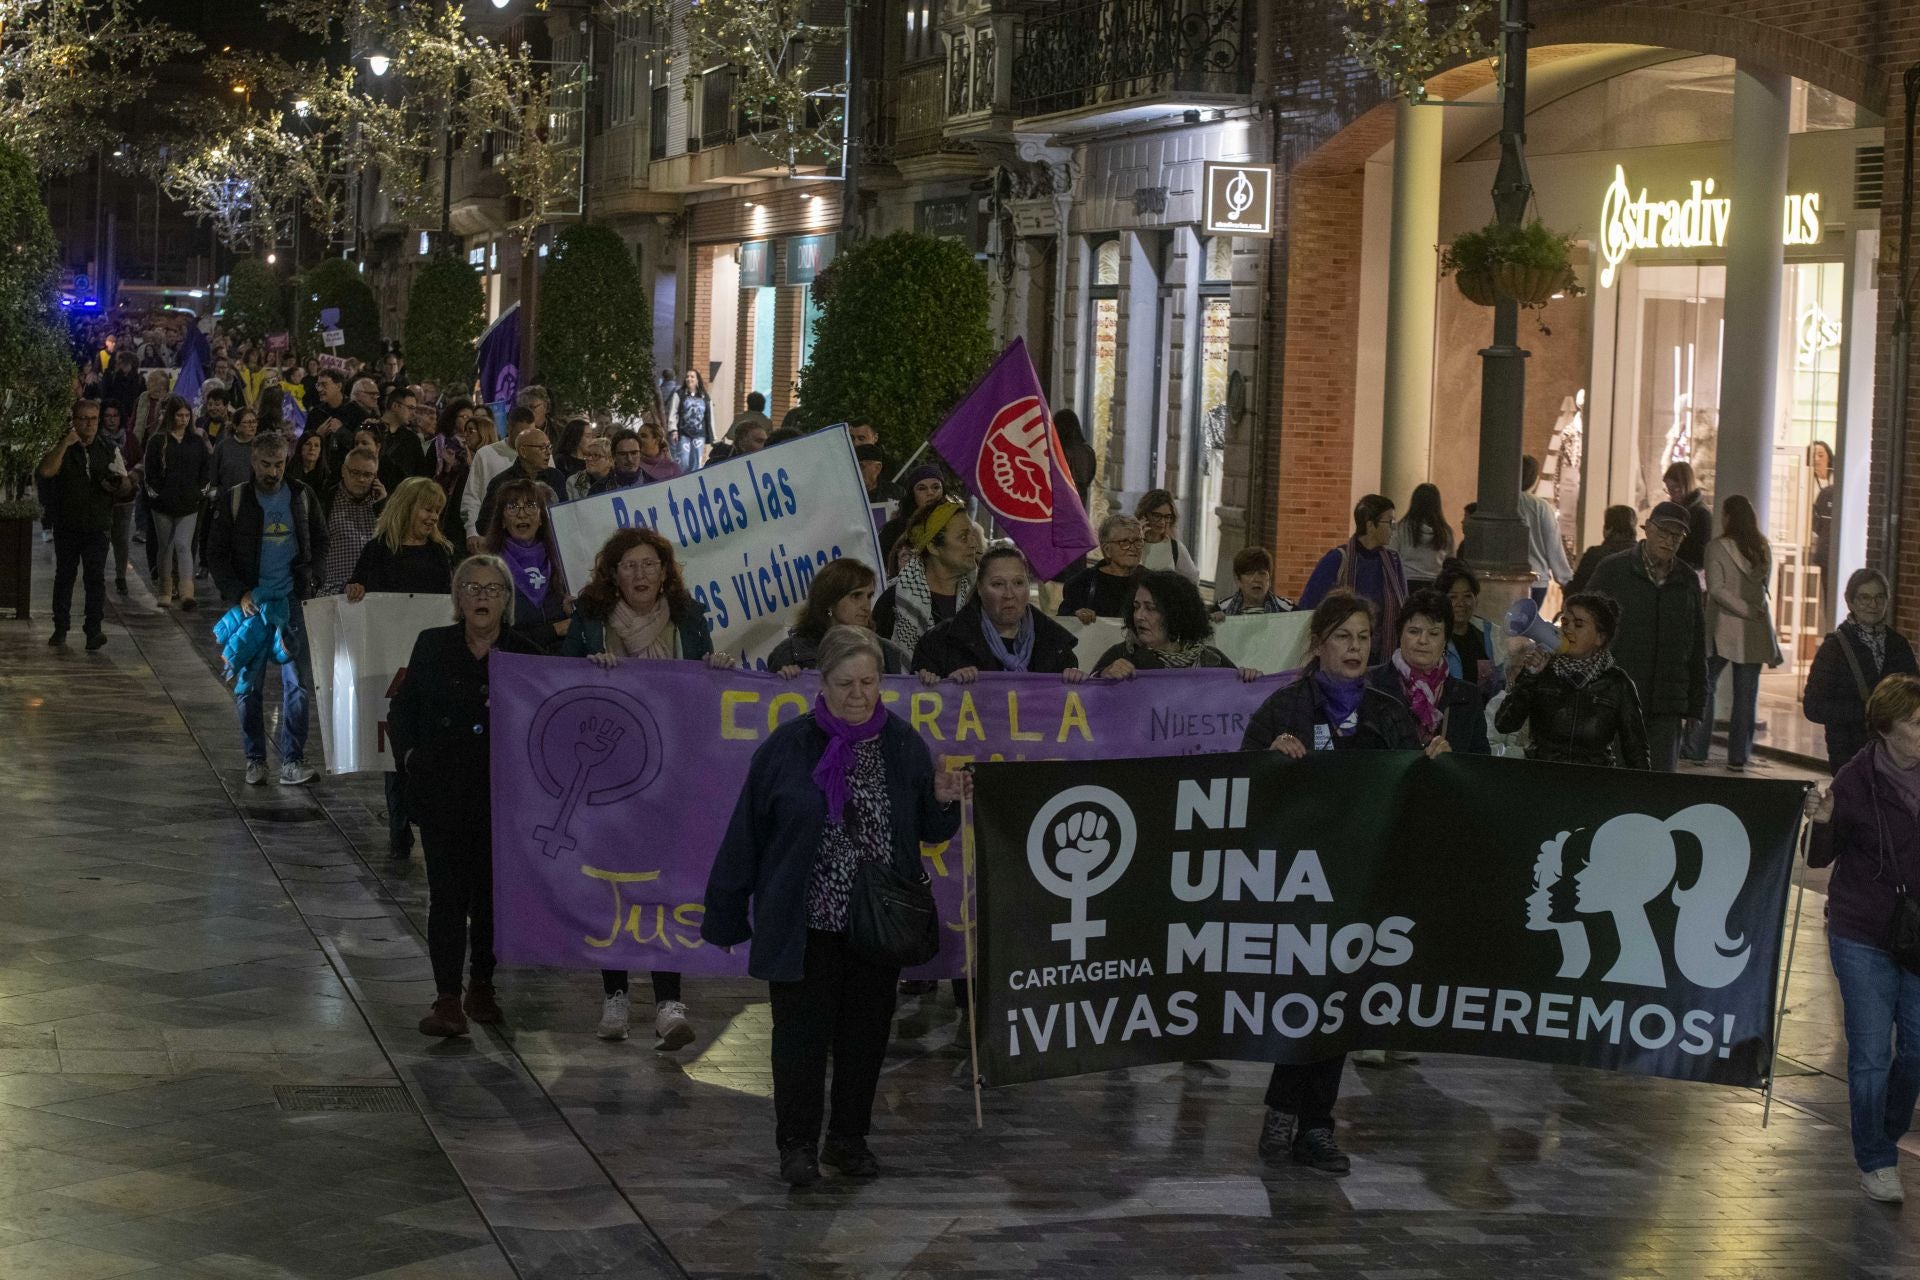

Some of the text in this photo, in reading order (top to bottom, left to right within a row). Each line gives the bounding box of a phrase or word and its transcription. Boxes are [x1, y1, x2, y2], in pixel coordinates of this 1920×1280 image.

[1622, 178, 1820, 249] stradivus
[668, 475, 748, 548] todas
[746, 460, 798, 523] las
[721, 689, 1096, 743] CORA LA
[1151, 706, 1246, 742] NUESTR
[1175, 777, 1250, 831] NI
[1170, 849, 1335, 902] UNA
[1166, 916, 1417, 976] MENOS
[1009, 957, 1155, 991] CARTAGENA
[1007, 982, 1737, 1060] ¡VIVAS NOS QUEREMOS!
